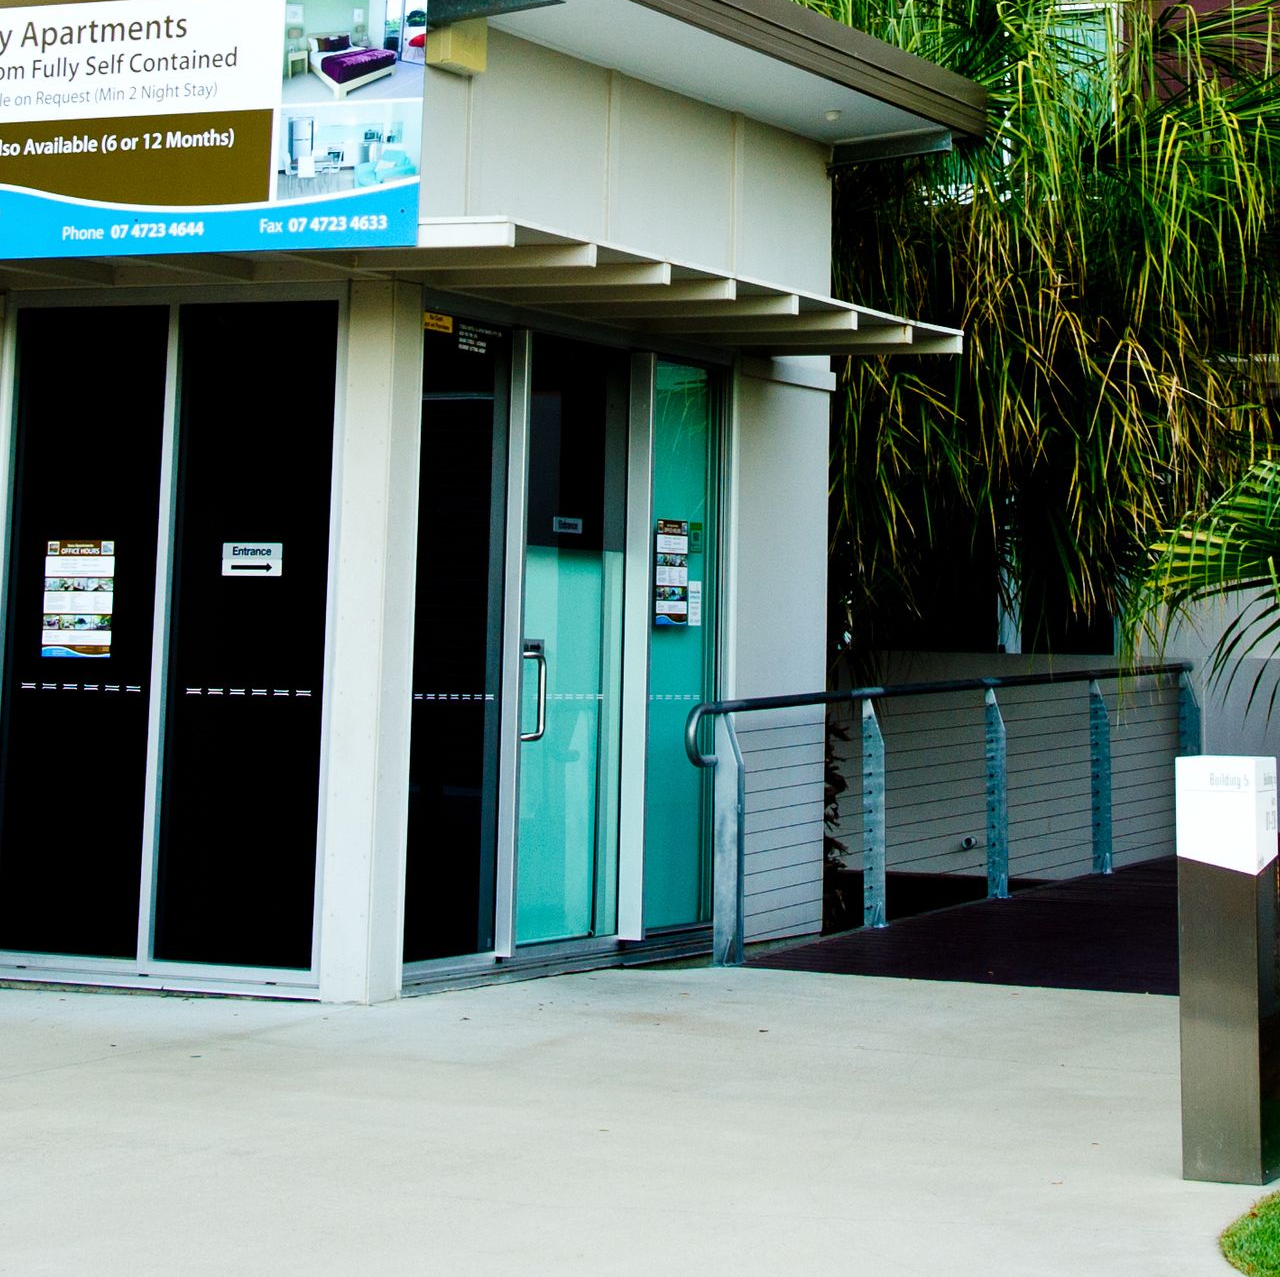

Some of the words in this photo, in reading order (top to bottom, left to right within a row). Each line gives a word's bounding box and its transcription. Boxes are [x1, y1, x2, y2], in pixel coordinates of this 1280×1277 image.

[20, 15, 188, 54] Apartments
[32, 57, 80, 82] Fully
[85, 53, 125, 76] Self
[129, 46, 238, 73] Contained
[14, 94, 32, 107] on
[36, 90, 91, 107] Request
[94, 87, 125, 104] (Min
[129, 86, 137, 100] 2
[141, 84, 180, 102] Night
[183, 82, 218, 100] Stay)
[23, 135, 98, 155] Available
[101, 134, 117, 154] (6
[120, 136, 139, 151] or
[143, 132, 162, 150] 12
[165, 128, 235, 149] Months)
[62, 225, 104, 241] Phone
[110, 224, 129, 239] 07
[131, 223, 166, 238] 4723
[168, 221, 204, 237] 4644
[259, 218, 283, 234] Fax
[288, 217, 307, 233] 07
[309, 216, 348, 232] 4723
[349, 215, 388, 231] 4633
[232, 546, 272, 556] Entrance
[1209, 772, 1241, 790] Building
